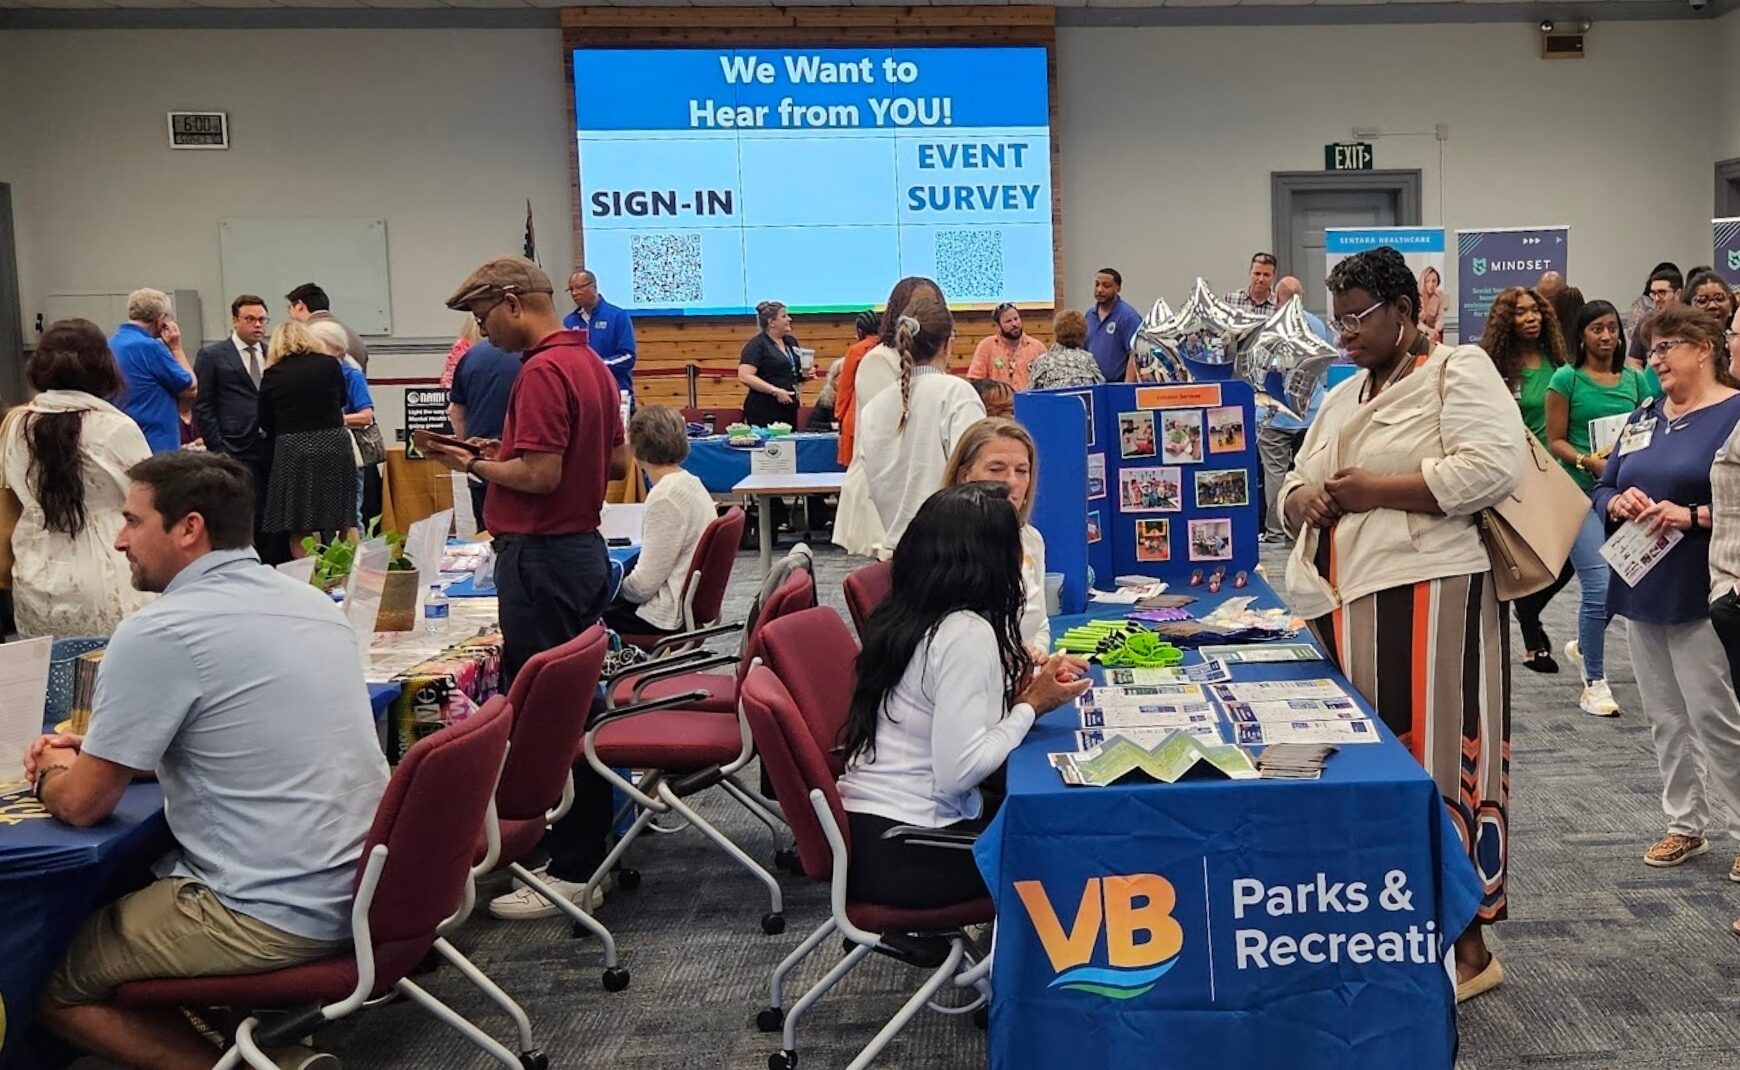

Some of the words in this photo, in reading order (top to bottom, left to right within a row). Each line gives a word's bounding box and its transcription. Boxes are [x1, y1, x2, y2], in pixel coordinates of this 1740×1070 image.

[719, 55, 776, 84] We
[783, 55, 874, 84] Want
[882, 56, 919, 83] to
[689, 99, 769, 128] Hear
[778, 97, 860, 127] from
[868, 97, 953, 127] YOU!
[917, 142, 1029, 170] EVENT
[1335, 145, 1365, 169] EXIT
[590, 188, 734, 218] SIGN-IN
[907, 184, 1041, 212] SURVEY
[1340, 236, 1376, 245] SENTARA
[1378, 236, 1431, 244] HEALTHCARE
[1490, 259, 1552, 272] MINDSET
[1231, 872, 1370, 919] Parks
[1378, 868, 1415, 912] &
[1013, 872, 1185, 974] VB
